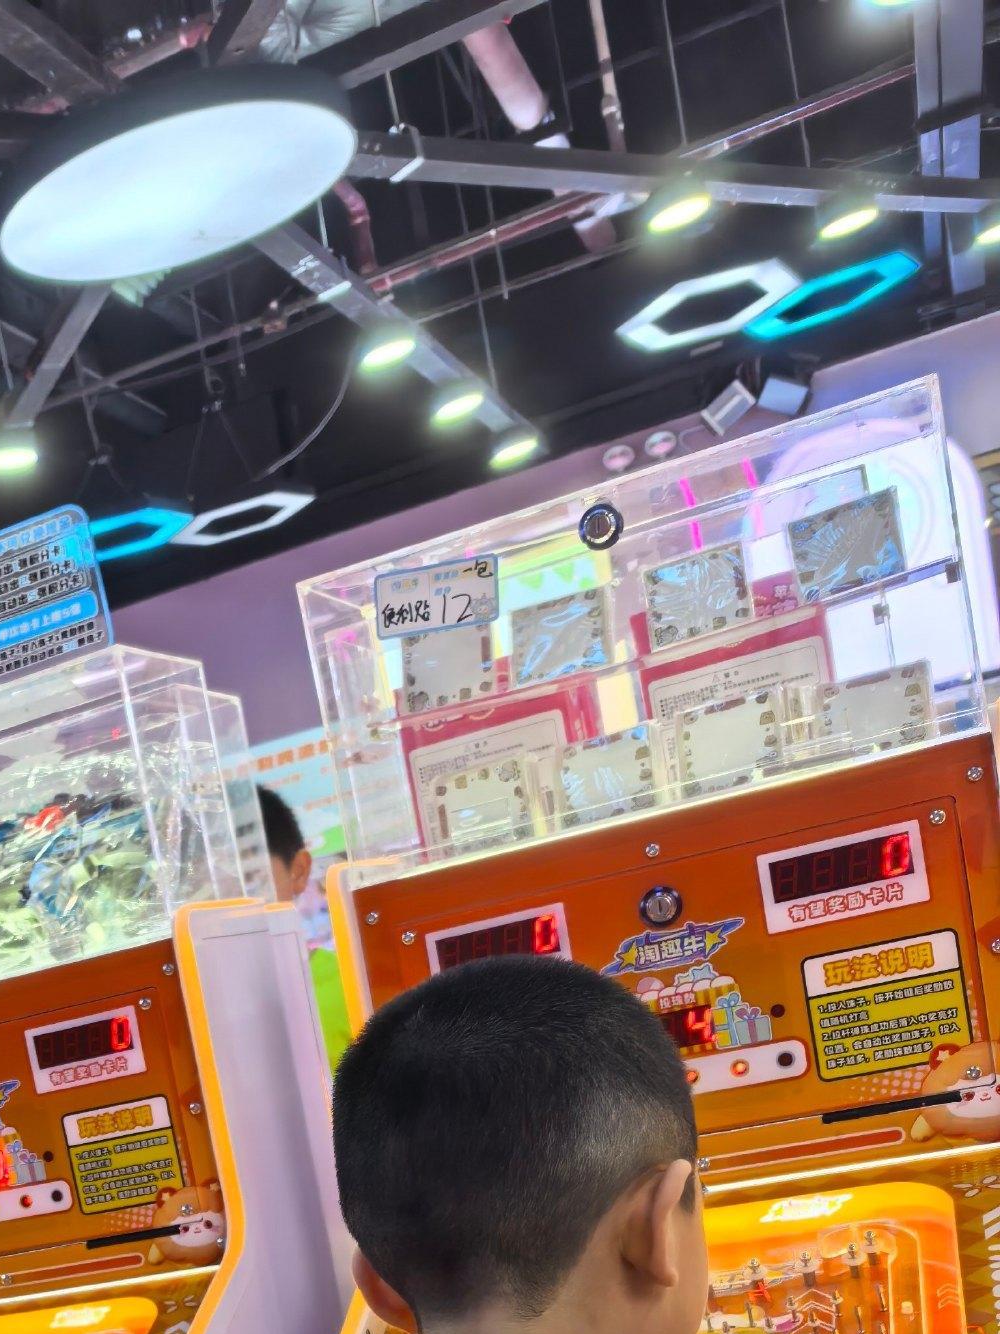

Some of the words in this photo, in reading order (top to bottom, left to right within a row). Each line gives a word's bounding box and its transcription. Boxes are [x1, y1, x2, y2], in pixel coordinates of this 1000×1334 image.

[788, 882, 904, 923] 有望奖励卡片
[638, 934, 706, 964] 淘趣牛
[823, 941, 935, 988] 玩法说明
